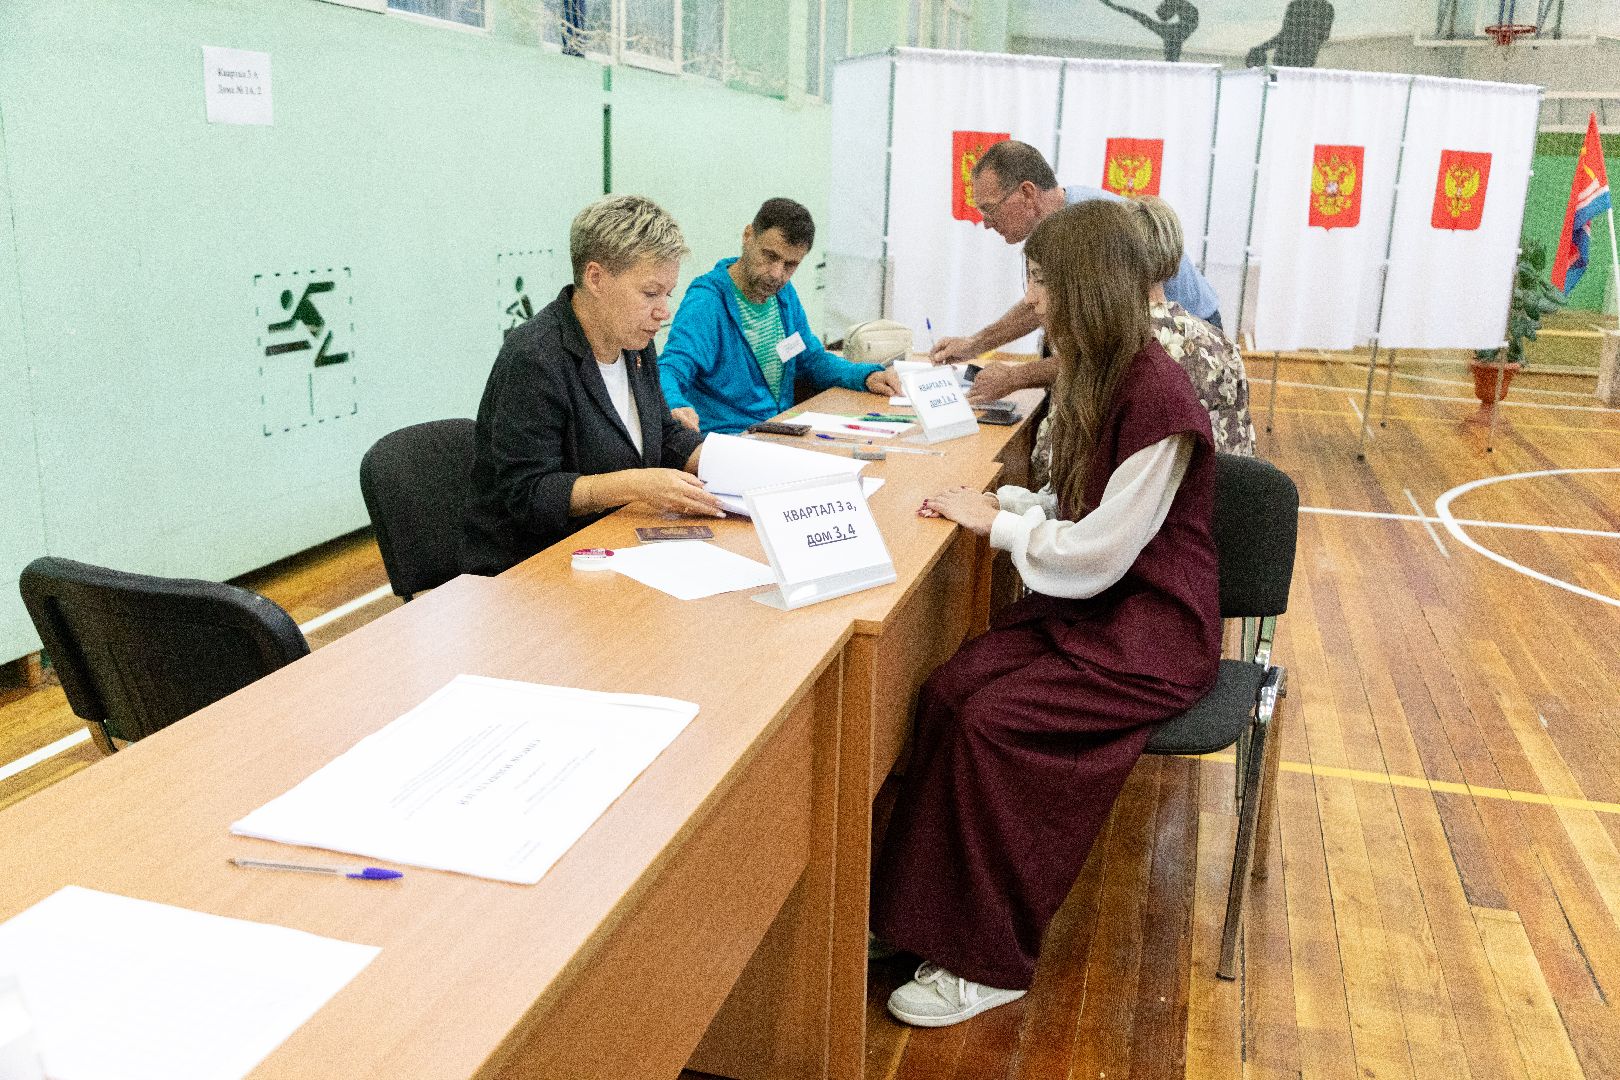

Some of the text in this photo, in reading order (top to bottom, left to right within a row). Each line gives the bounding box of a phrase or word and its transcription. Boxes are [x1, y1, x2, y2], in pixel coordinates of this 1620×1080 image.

[783, 500, 857, 522] КВАРТАЛ 3 а,
[833, 525, 846, 540] 3,
[848, 523, 855, 535] 4
